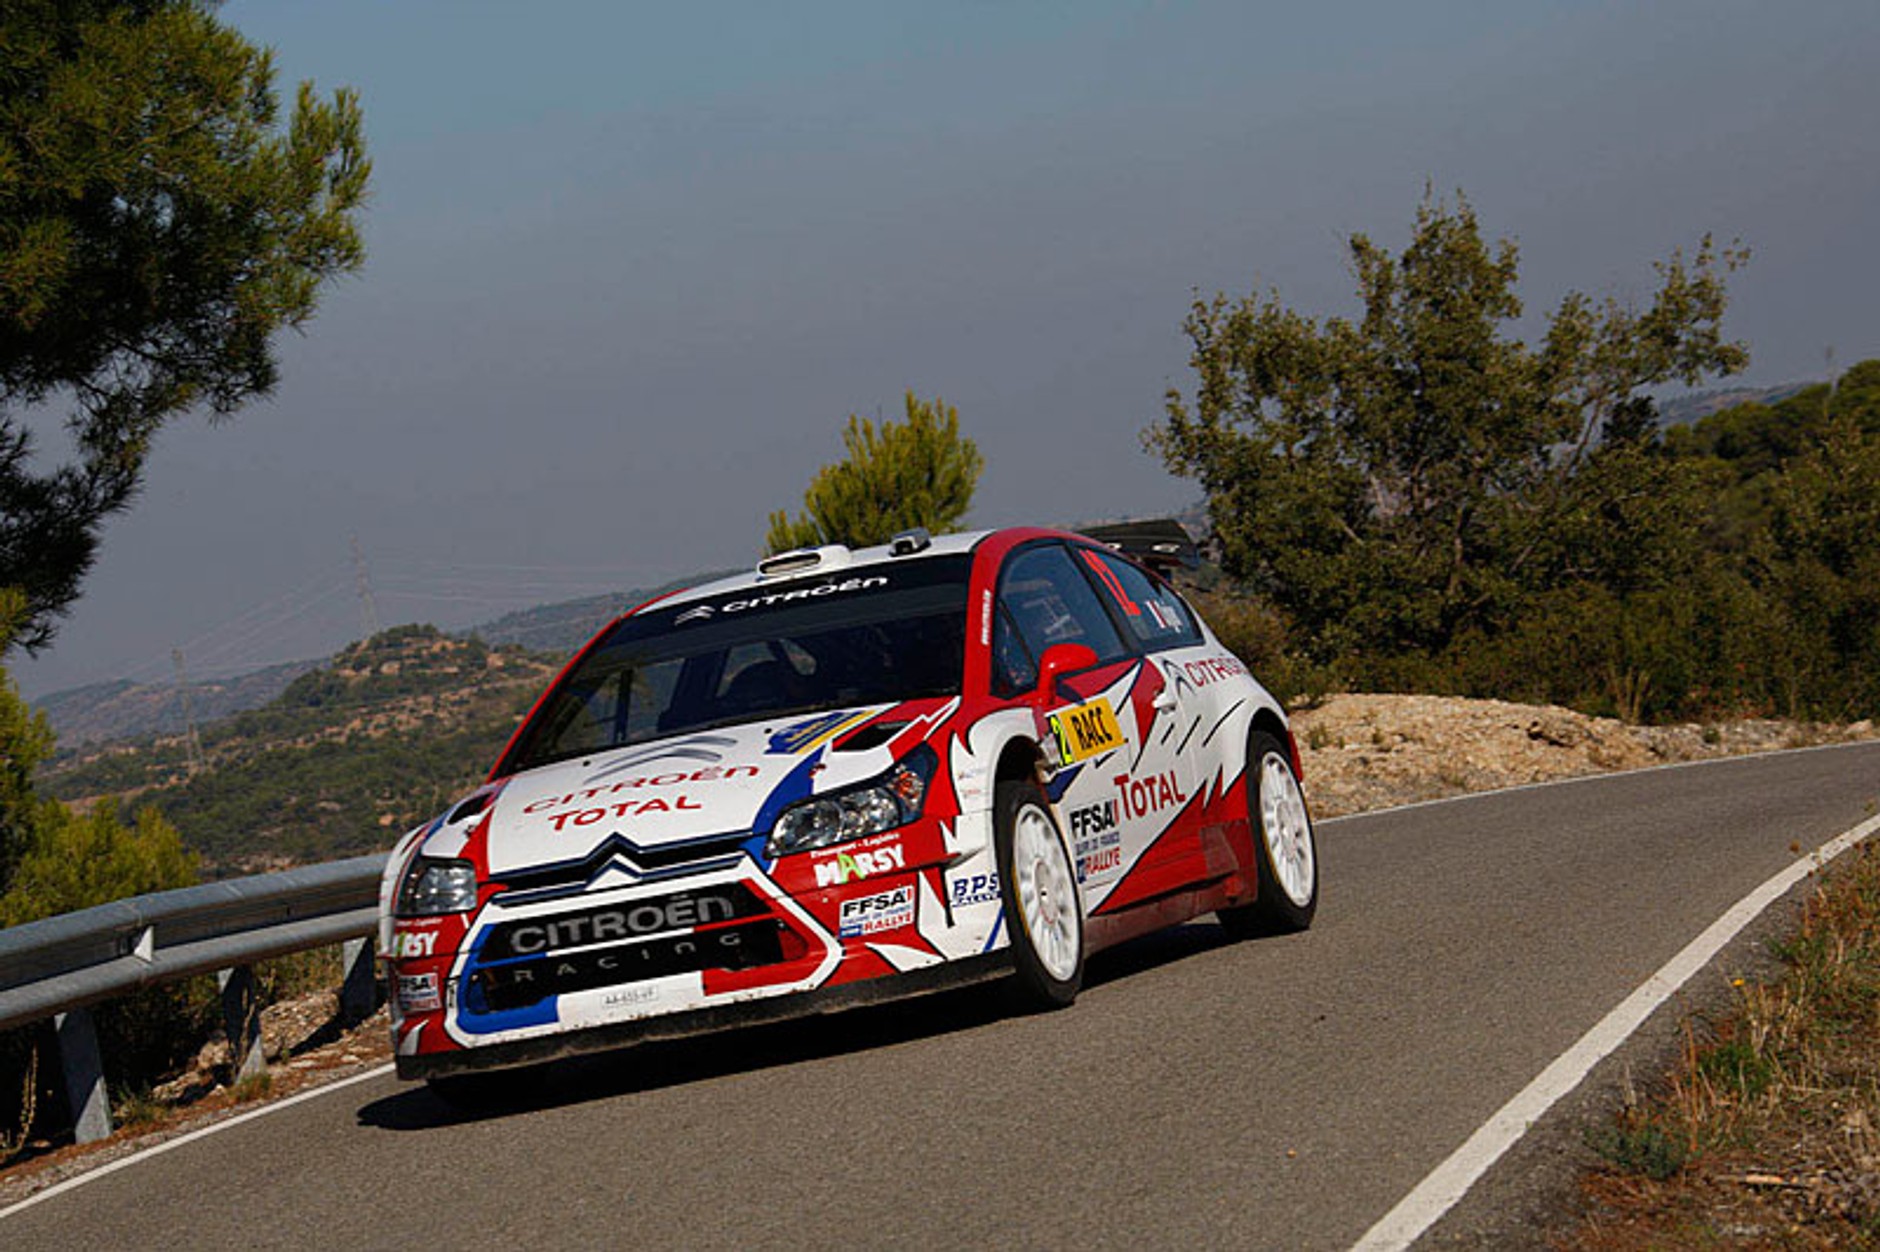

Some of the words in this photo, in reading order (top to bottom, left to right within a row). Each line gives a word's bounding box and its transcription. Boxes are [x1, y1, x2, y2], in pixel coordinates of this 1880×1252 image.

[1071, 706, 1113, 751] RACC
[547, 795, 702, 831] TOTAL
[1113, 769, 1186, 821] TOTAL
[1069, 800, 1116, 838] FFSA
[813, 843, 906, 889] MARSY
[1086, 845, 1121, 875] RALLYE
[953, 872, 999, 897] BPS
[843, 890, 908, 918] FFSA
[514, 931, 742, 982] RACING
